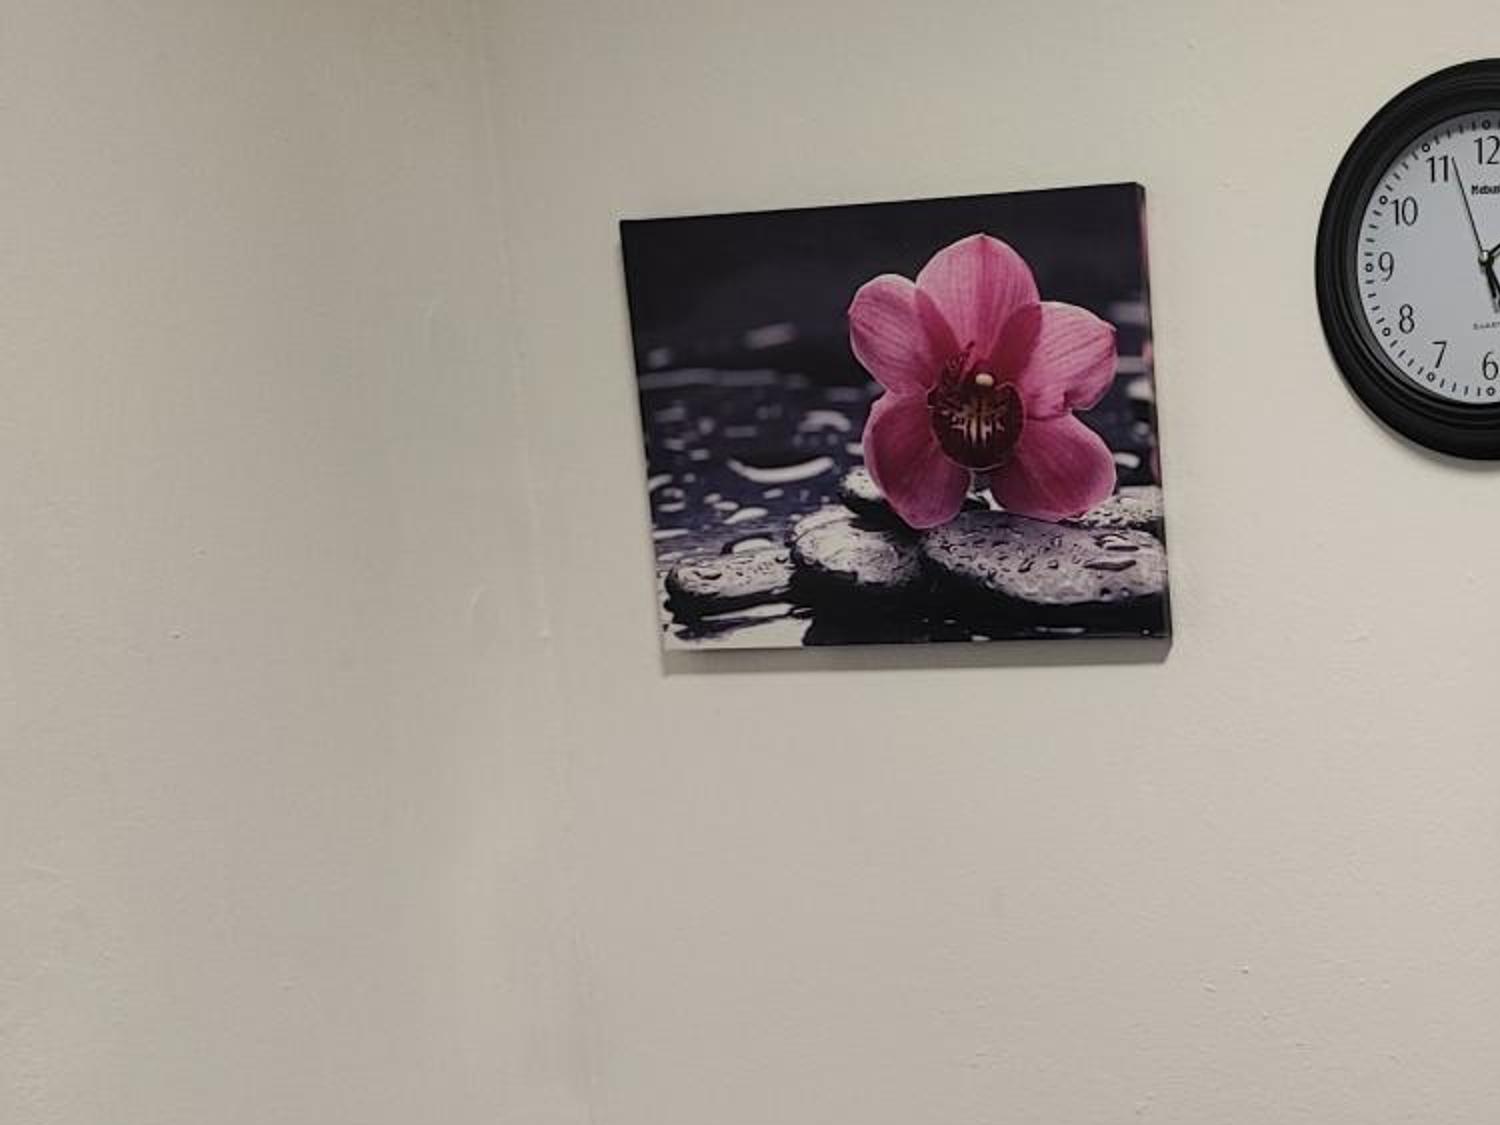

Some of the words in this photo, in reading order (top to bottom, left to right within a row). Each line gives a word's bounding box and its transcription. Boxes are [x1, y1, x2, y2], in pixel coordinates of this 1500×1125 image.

[1474, 135, 1500, 165] 12
[1426, 155, 1451, 183] 11
[1391, 196, 1418, 226] 10
[1378, 251, 1395, 281] 9
[1398, 304, 1416, 334] 8
[1432, 341, 1448, 369] 7
[1482, 351, 1500, 380] 6
